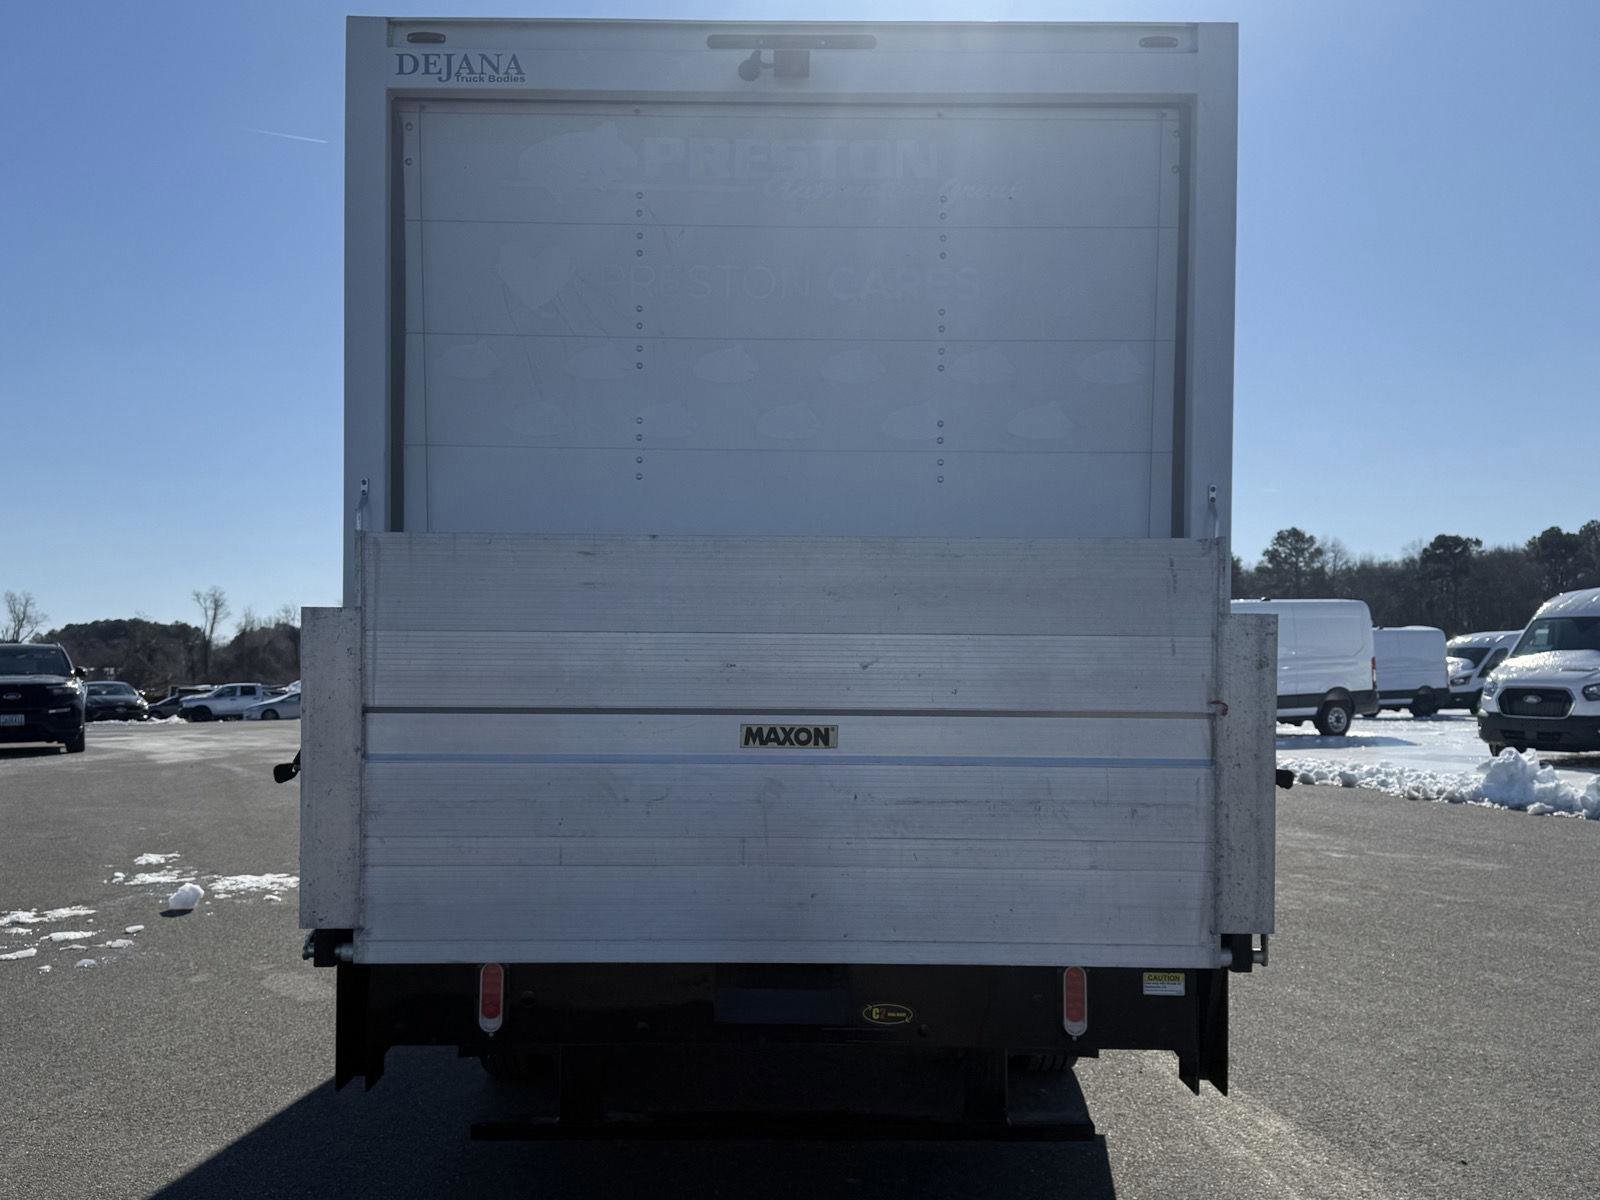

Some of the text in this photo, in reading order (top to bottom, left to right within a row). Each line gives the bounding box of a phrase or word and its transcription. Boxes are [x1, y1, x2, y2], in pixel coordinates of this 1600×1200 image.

[394, 52, 526, 82] DEJANA
[455, 74, 526, 83] Truck Bodies
[743, 726, 830, 747] MAXON
[1146, 974, 1181, 982] CAUTION
